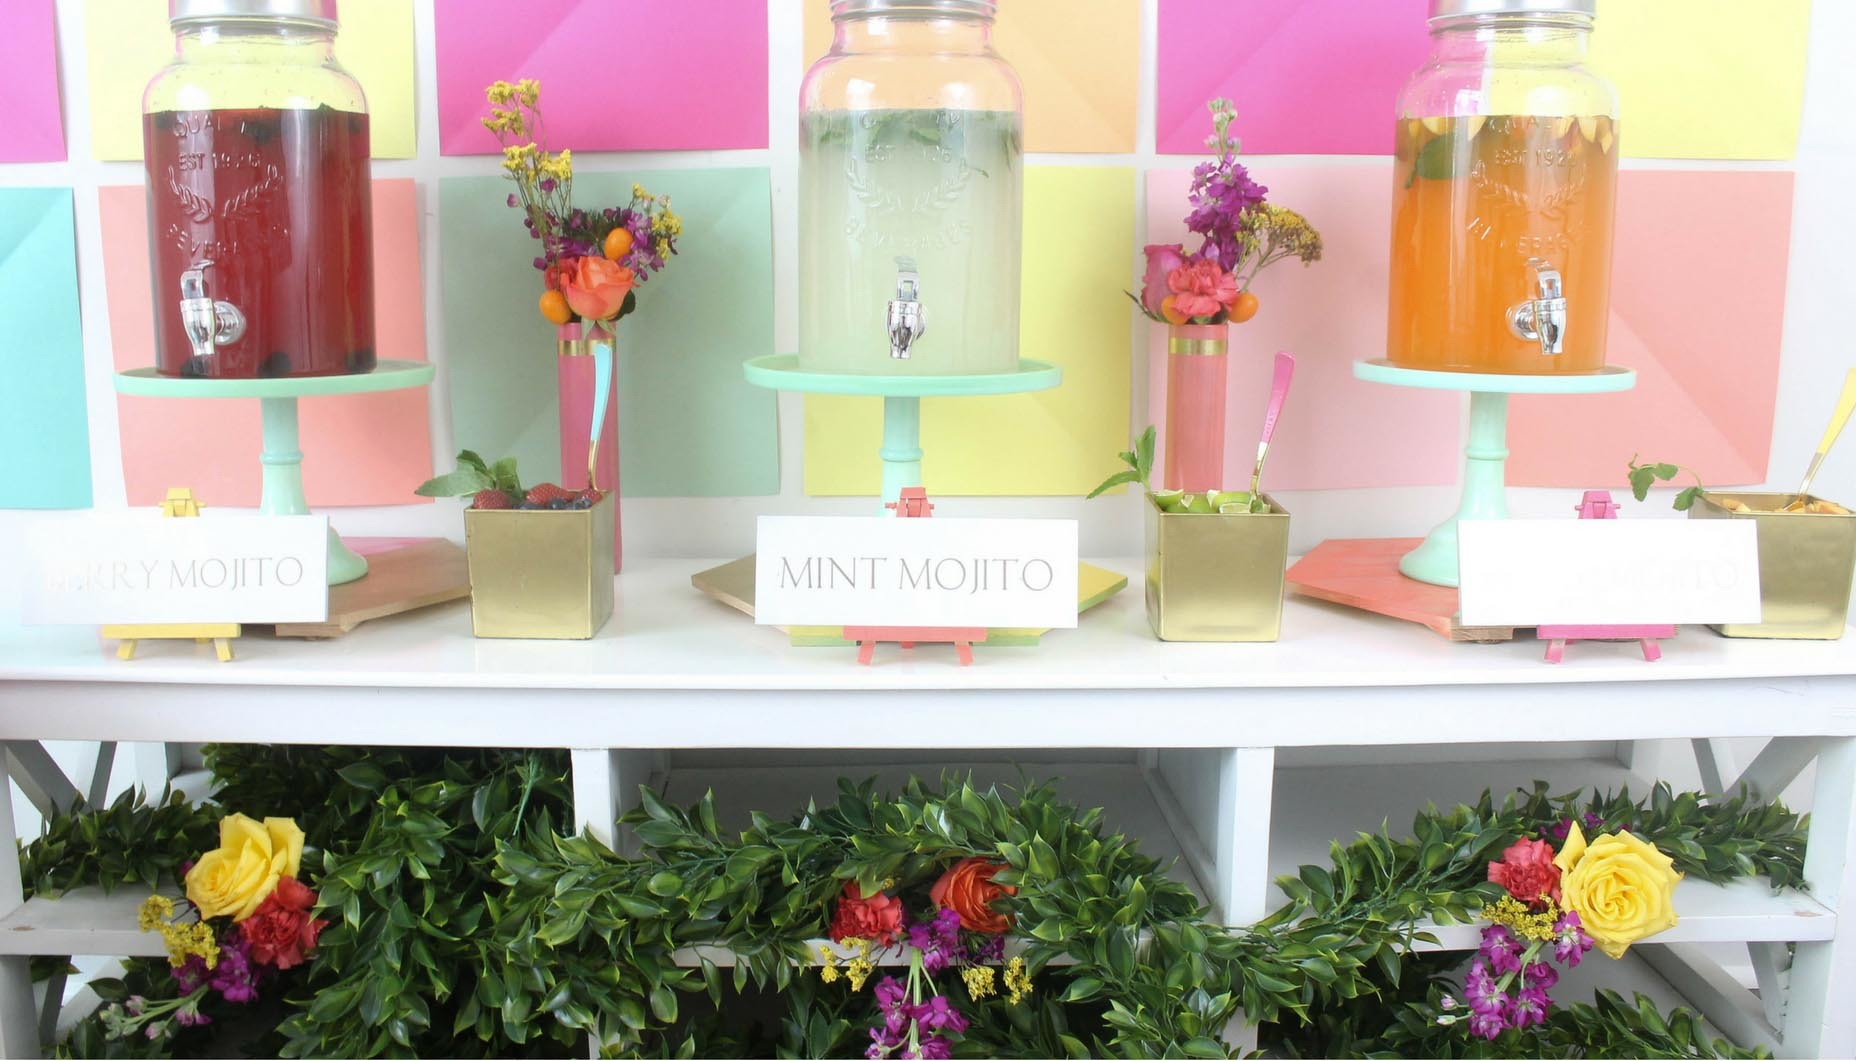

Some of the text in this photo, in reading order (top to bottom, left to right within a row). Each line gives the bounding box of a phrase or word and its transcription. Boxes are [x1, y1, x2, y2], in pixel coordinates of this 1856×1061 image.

[178, 152, 206, 172] EST
[46, 556, 304, 592] RRY MOJITO
[779, 555, 1054, 595] MINT MOJITO
